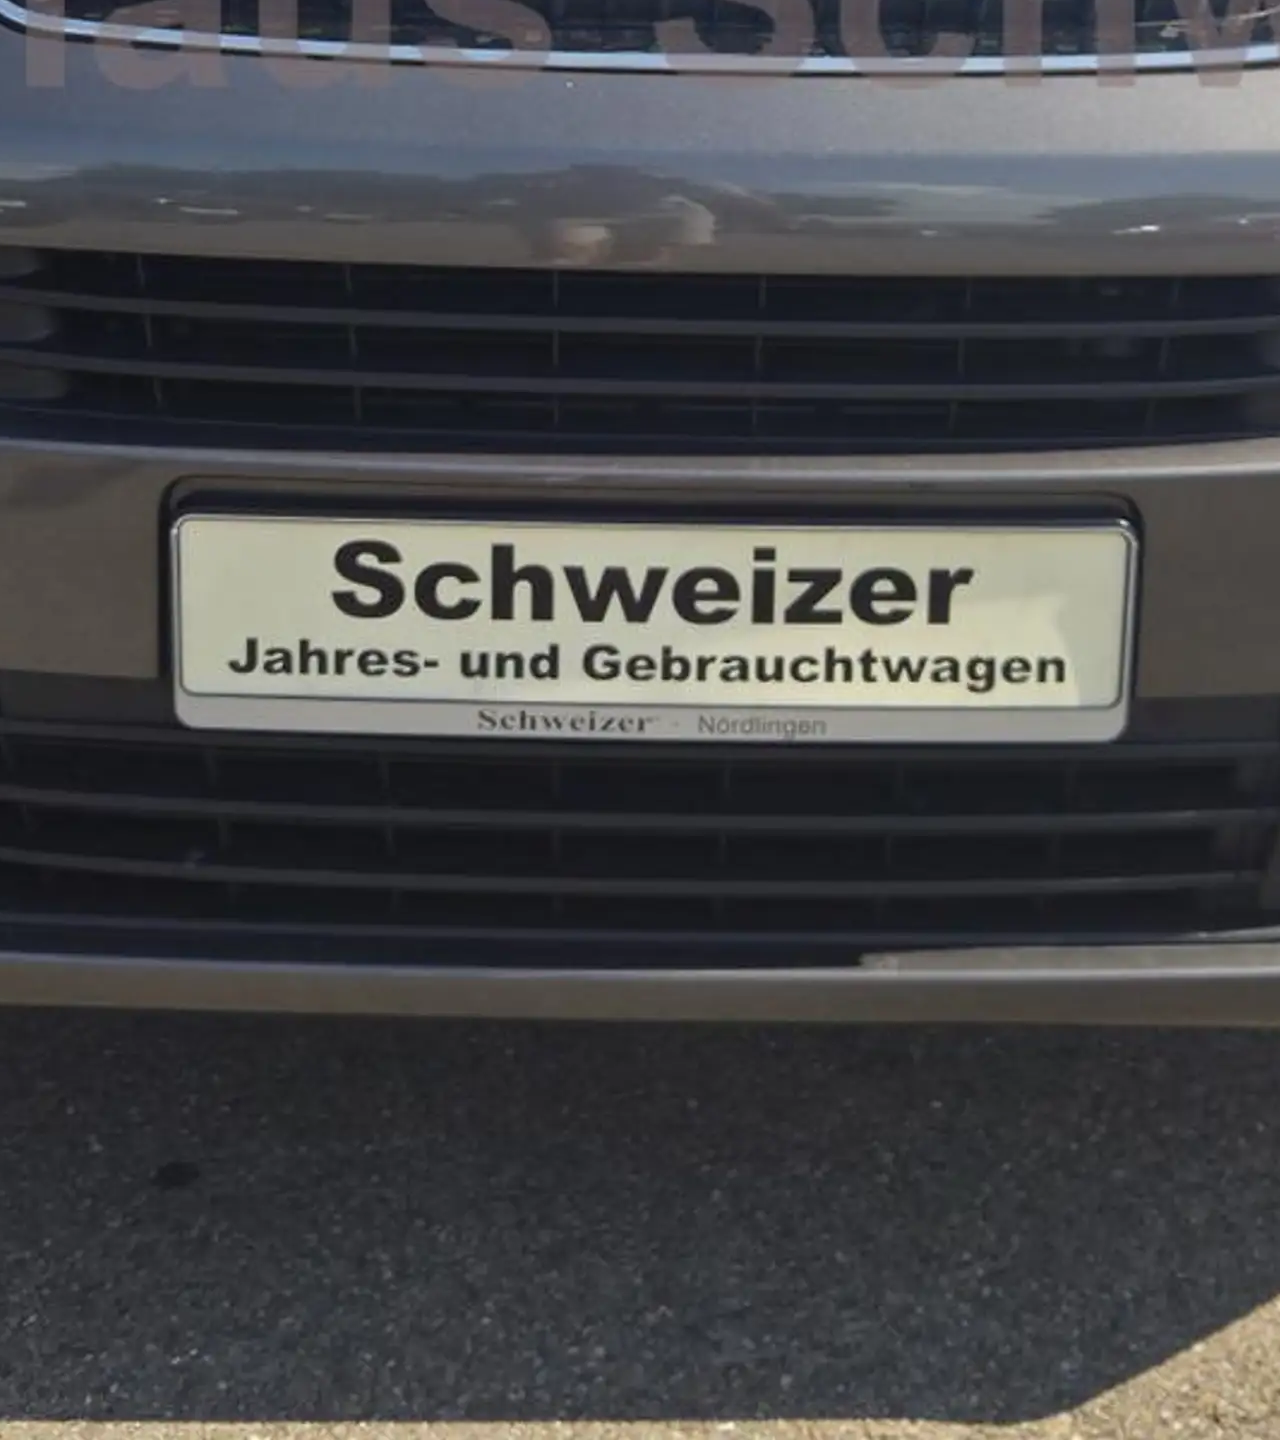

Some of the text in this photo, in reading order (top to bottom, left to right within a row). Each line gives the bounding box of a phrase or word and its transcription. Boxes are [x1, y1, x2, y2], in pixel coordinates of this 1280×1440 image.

[331, 538, 975, 625] Schweizer
[228, 637, 1067, 694] Jahres- und Gebrauchtwagen
[476, 708, 657, 733] Schweizer
